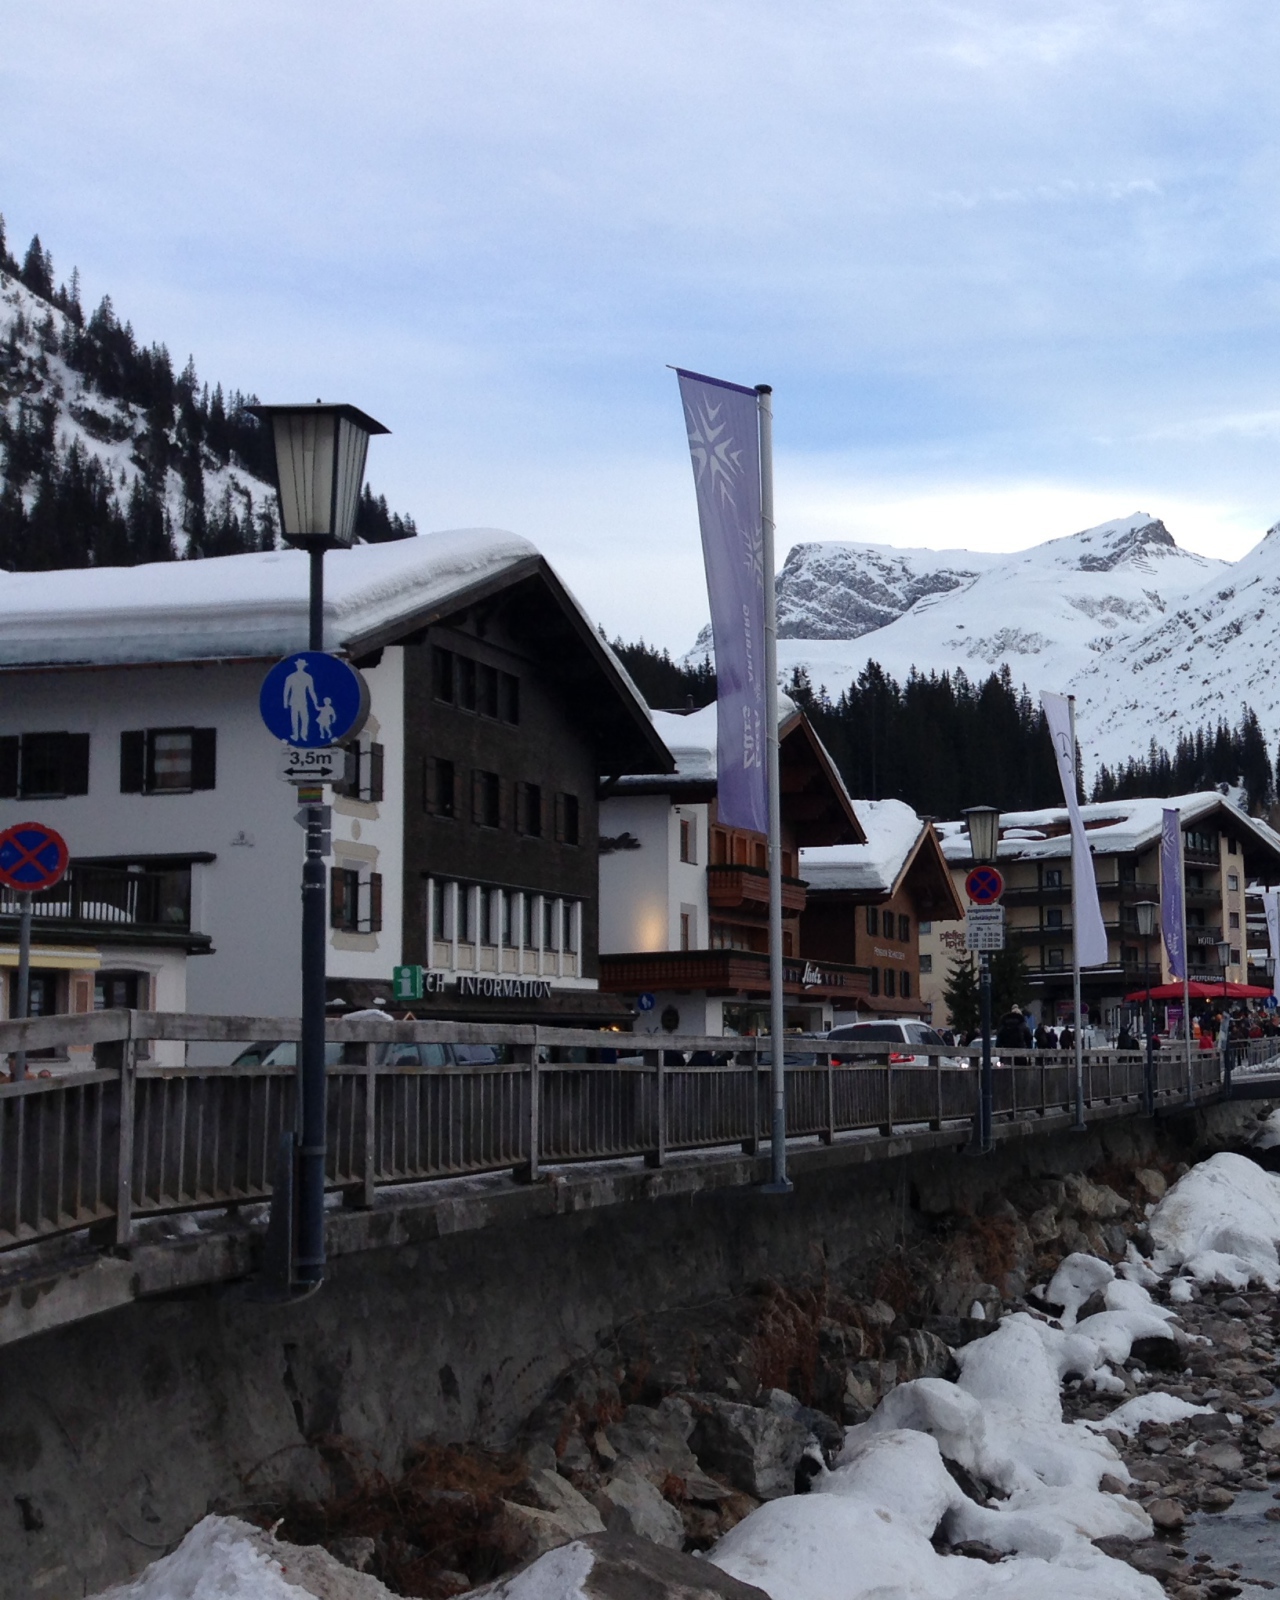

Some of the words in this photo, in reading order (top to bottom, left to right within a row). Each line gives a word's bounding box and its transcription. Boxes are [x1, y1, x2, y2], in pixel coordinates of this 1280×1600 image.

[289, 751, 332, 766] 3,5m
[1197, 936, 1215, 945] HOTEL
[459, 977, 552, 998] INFORMATION
